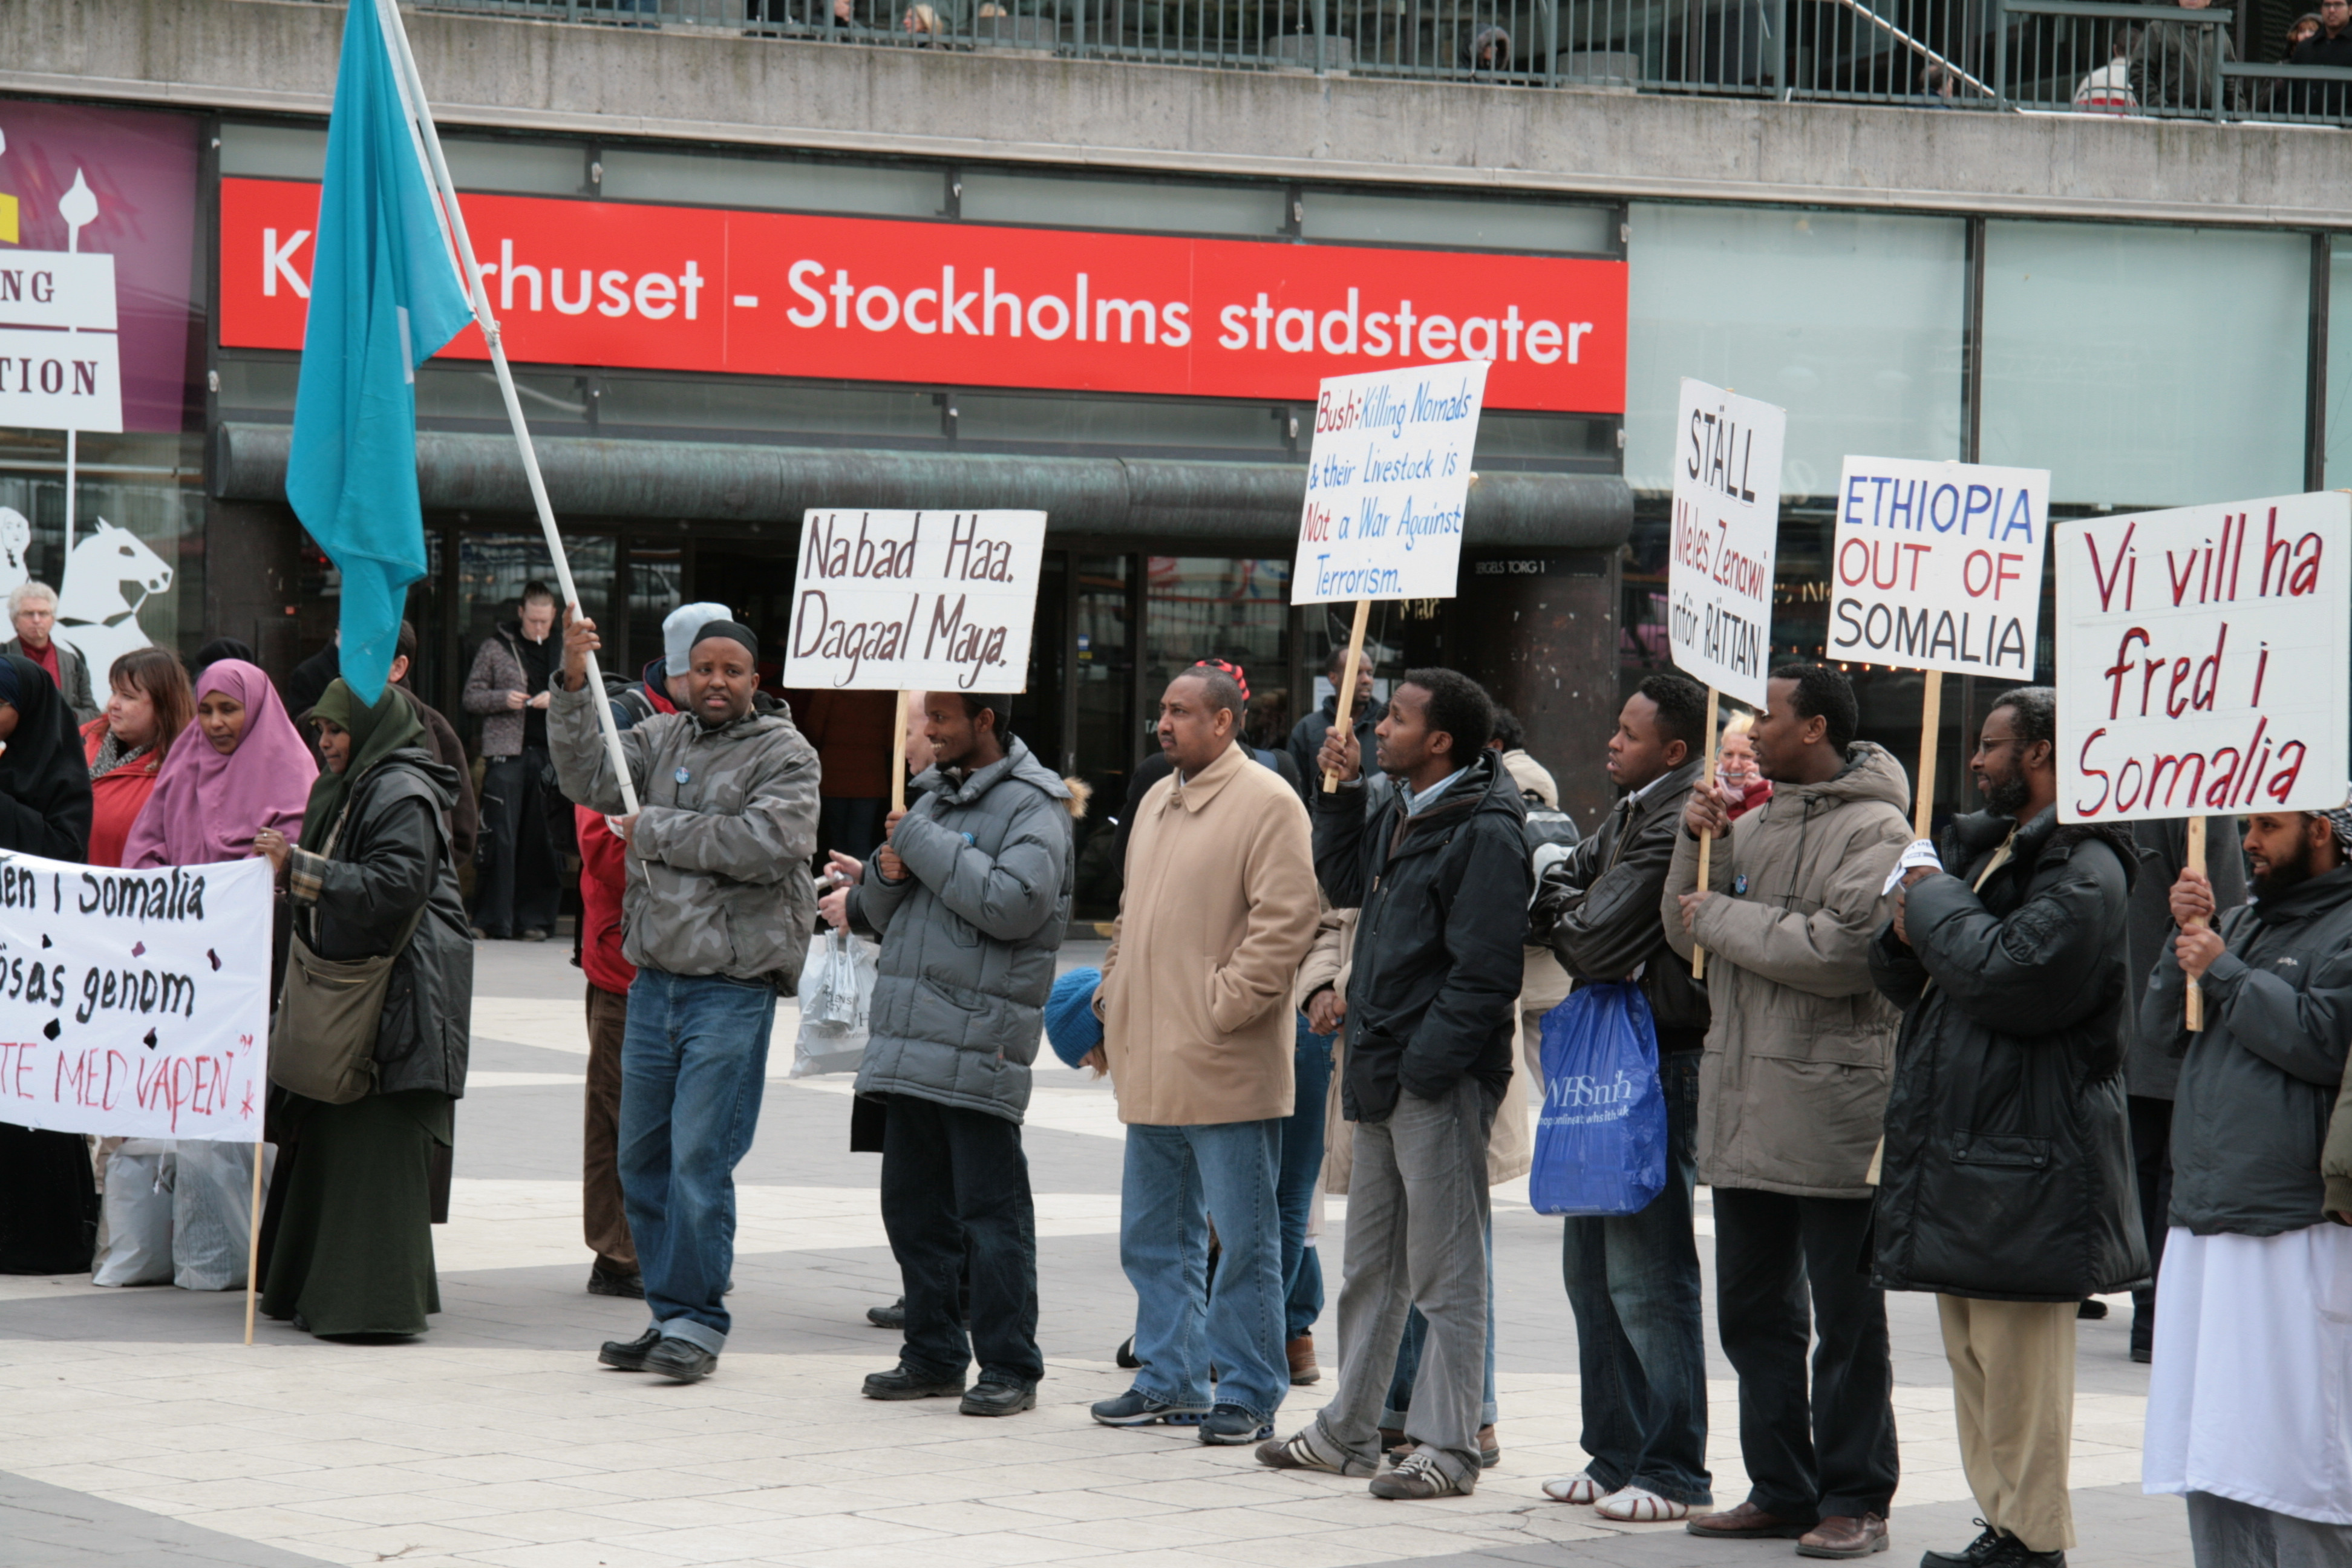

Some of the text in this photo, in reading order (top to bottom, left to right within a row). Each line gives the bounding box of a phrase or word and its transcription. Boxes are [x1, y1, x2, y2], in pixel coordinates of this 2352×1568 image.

[733, 295, 758, 307] -
[787, 260, 1191, 347] Stockholms
[1218, 287, 1593, 364] stadsteater
[1410, 376, 1472, 423] Nomads
[1309, 442, 1458, 491] & their Livestock is
[1688, 405, 1755, 503] STÄLL
[1302, 495, 1462, 550] Not a War Against
[1844, 475, 2033, 544] ETHIOPIA
[804, 512, 1014, 583] Nabad Haa.
[1315, 554, 1403, 596] Terrorism.
[1508, 560, 1537, 574] TORG
[1674, 497, 1767, 603] Meles Zenawi
[1839, 537, 2024, 601] OUT OF
[2083, 506, 2323, 612] Vi vill ha
[793, 590, 1007, 689] Dagaal Maya.
[1672, 589, 1762, 679] inför RÄTTAN
[1834, 598, 2025, 670] SOMALIA
[2105, 621, 2268, 720] fred i
[2076, 715, 2306, 817] Somalia
[0, 855, 36, 909] en
[79, 866, 206, 923] Somalia
[76, 967, 195, 1024] genom
[54, 1048, 128, 1111] MED
